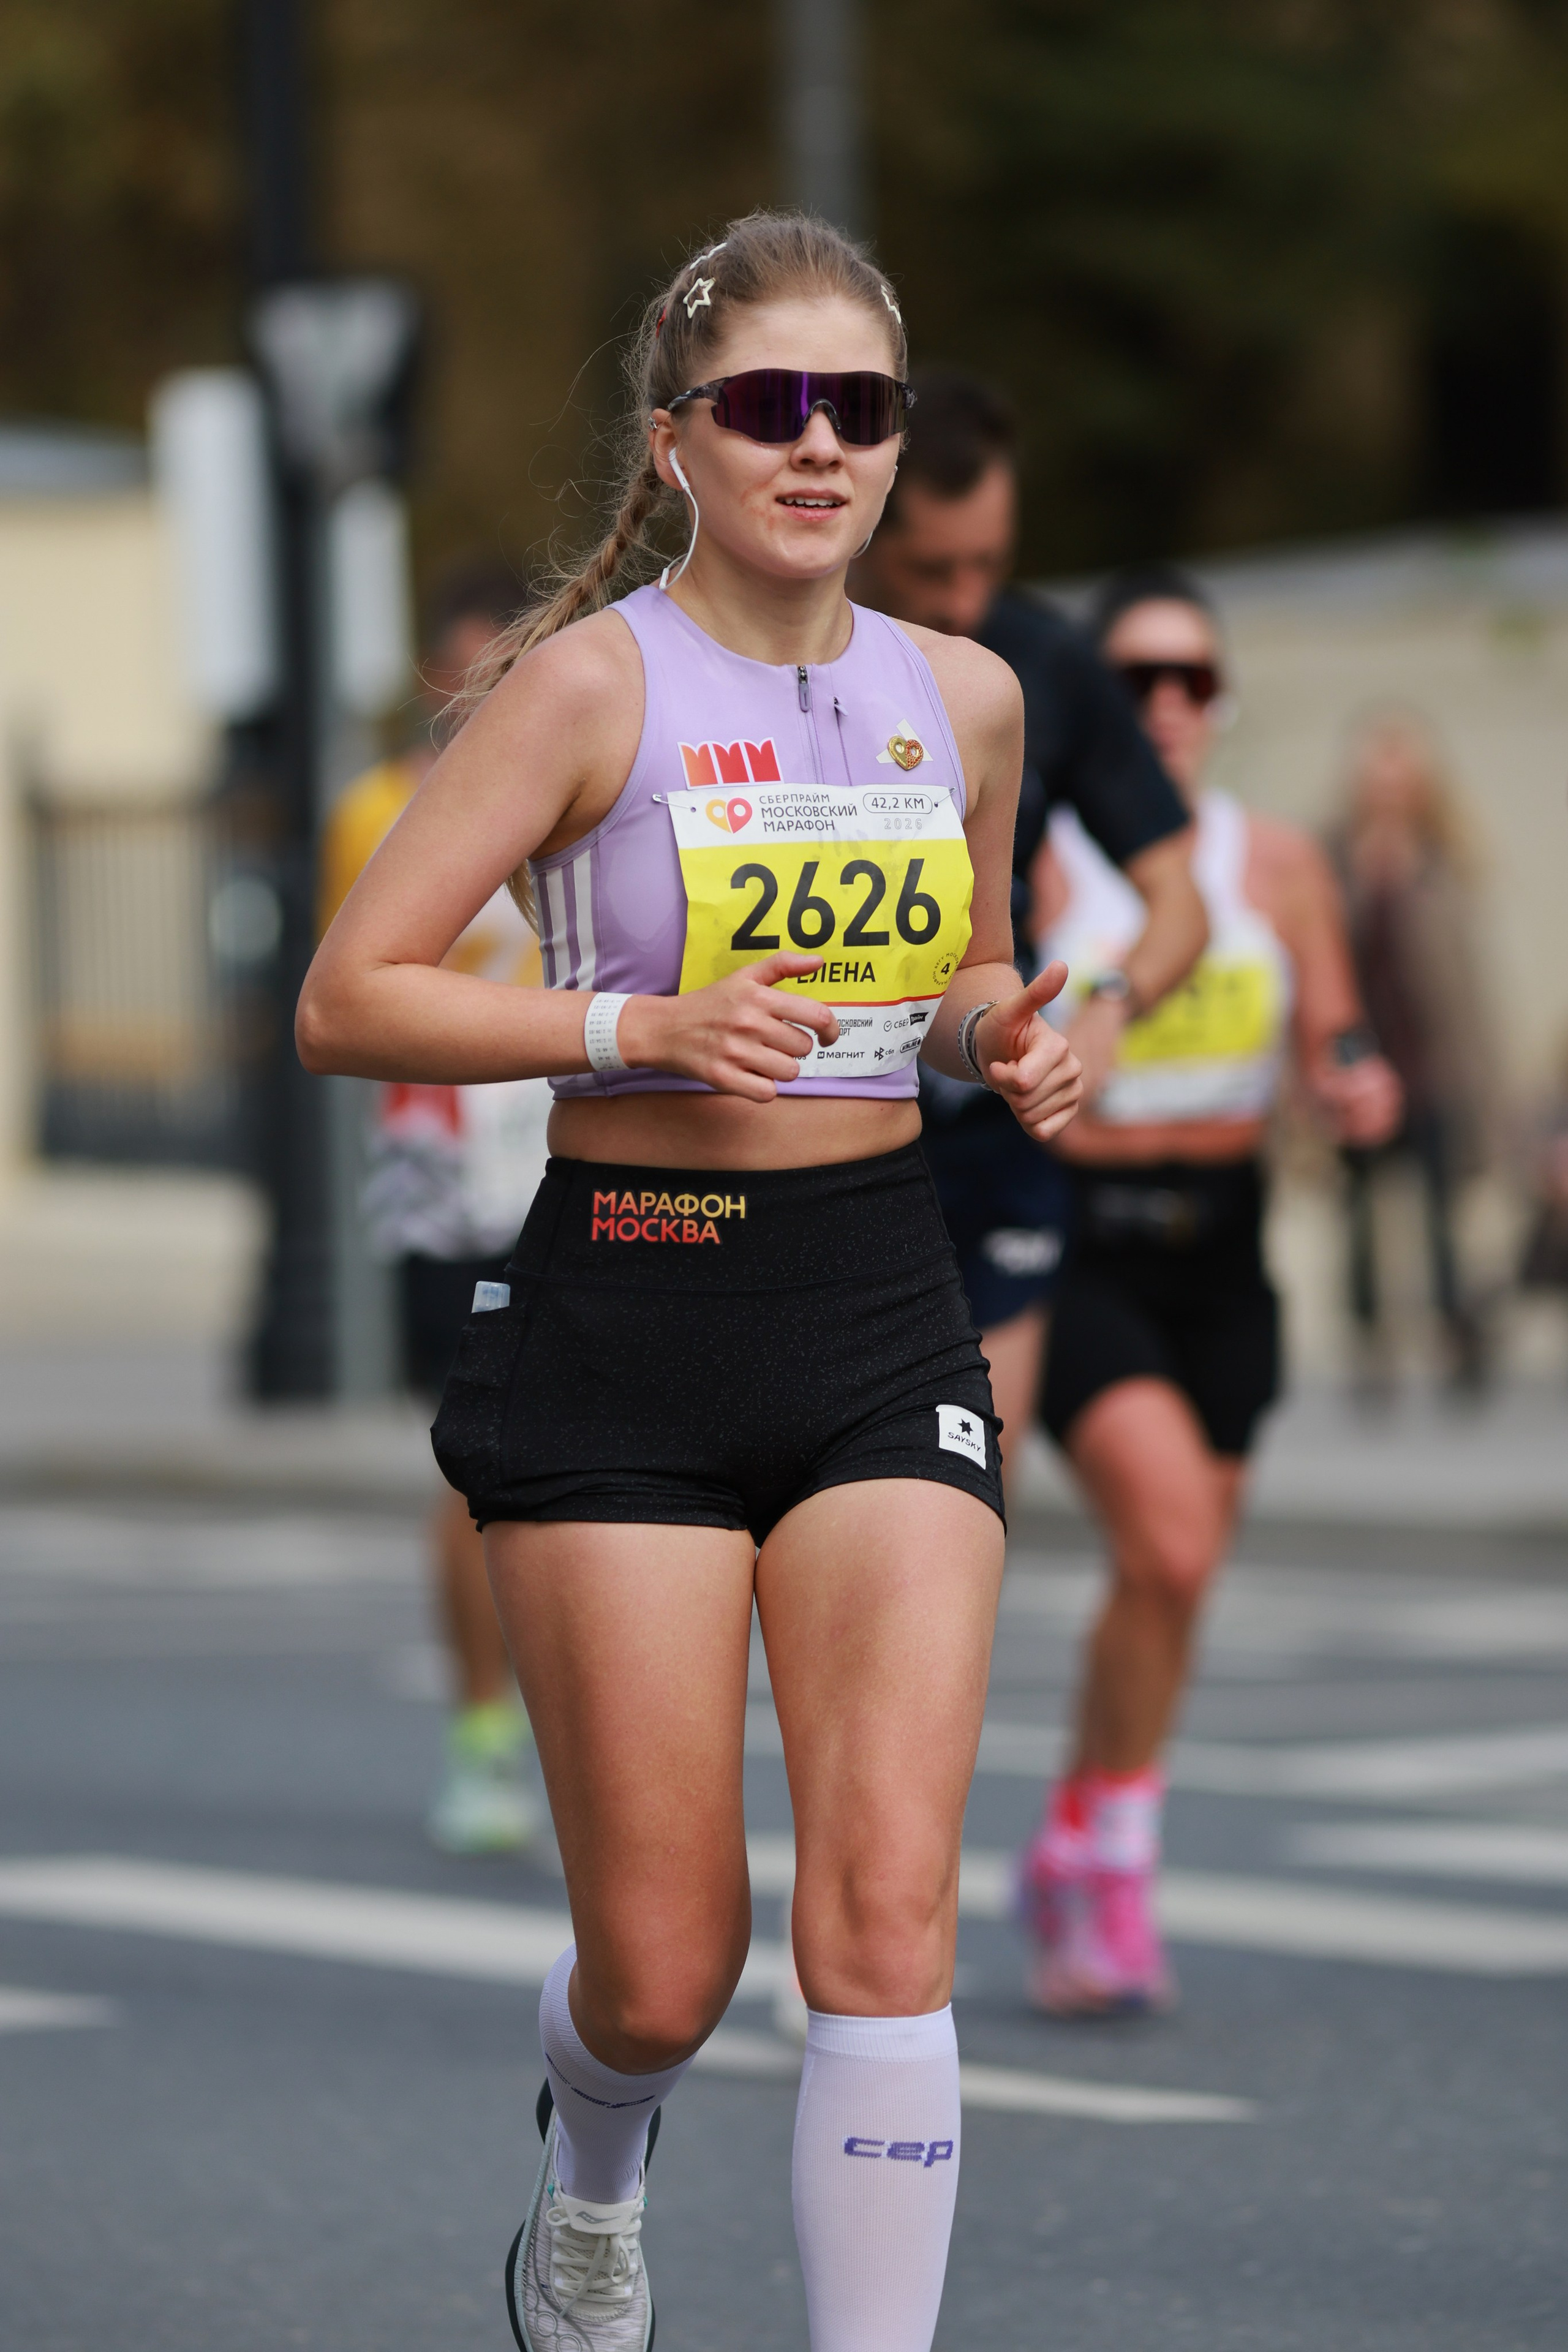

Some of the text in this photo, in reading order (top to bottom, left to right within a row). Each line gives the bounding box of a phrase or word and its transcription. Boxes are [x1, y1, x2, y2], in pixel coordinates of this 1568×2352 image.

[759, 793, 830, 804] СБЕРПРАЙМ
[872, 797, 924, 810] 42,2 КМ
[761, 803, 858, 818] МОСКОВСКИЙ
[764, 820, 835, 832] МАРАФОН
[884, 818, 922, 829] 2026
[730, 858, 941, 950] 2626
[941, 962, 950, 974] 4
[837, 1017, 873, 1027] ОСКОВСКИЙ
[894, 1018, 910, 1028] СБЕР
[593, 1191, 745, 1219] МАРАФОН
[591, 1217, 720, 1244] МОСКВА
[948, 1432, 981, 1452] SAYSKY
[844, 2137, 954, 2168] cep
